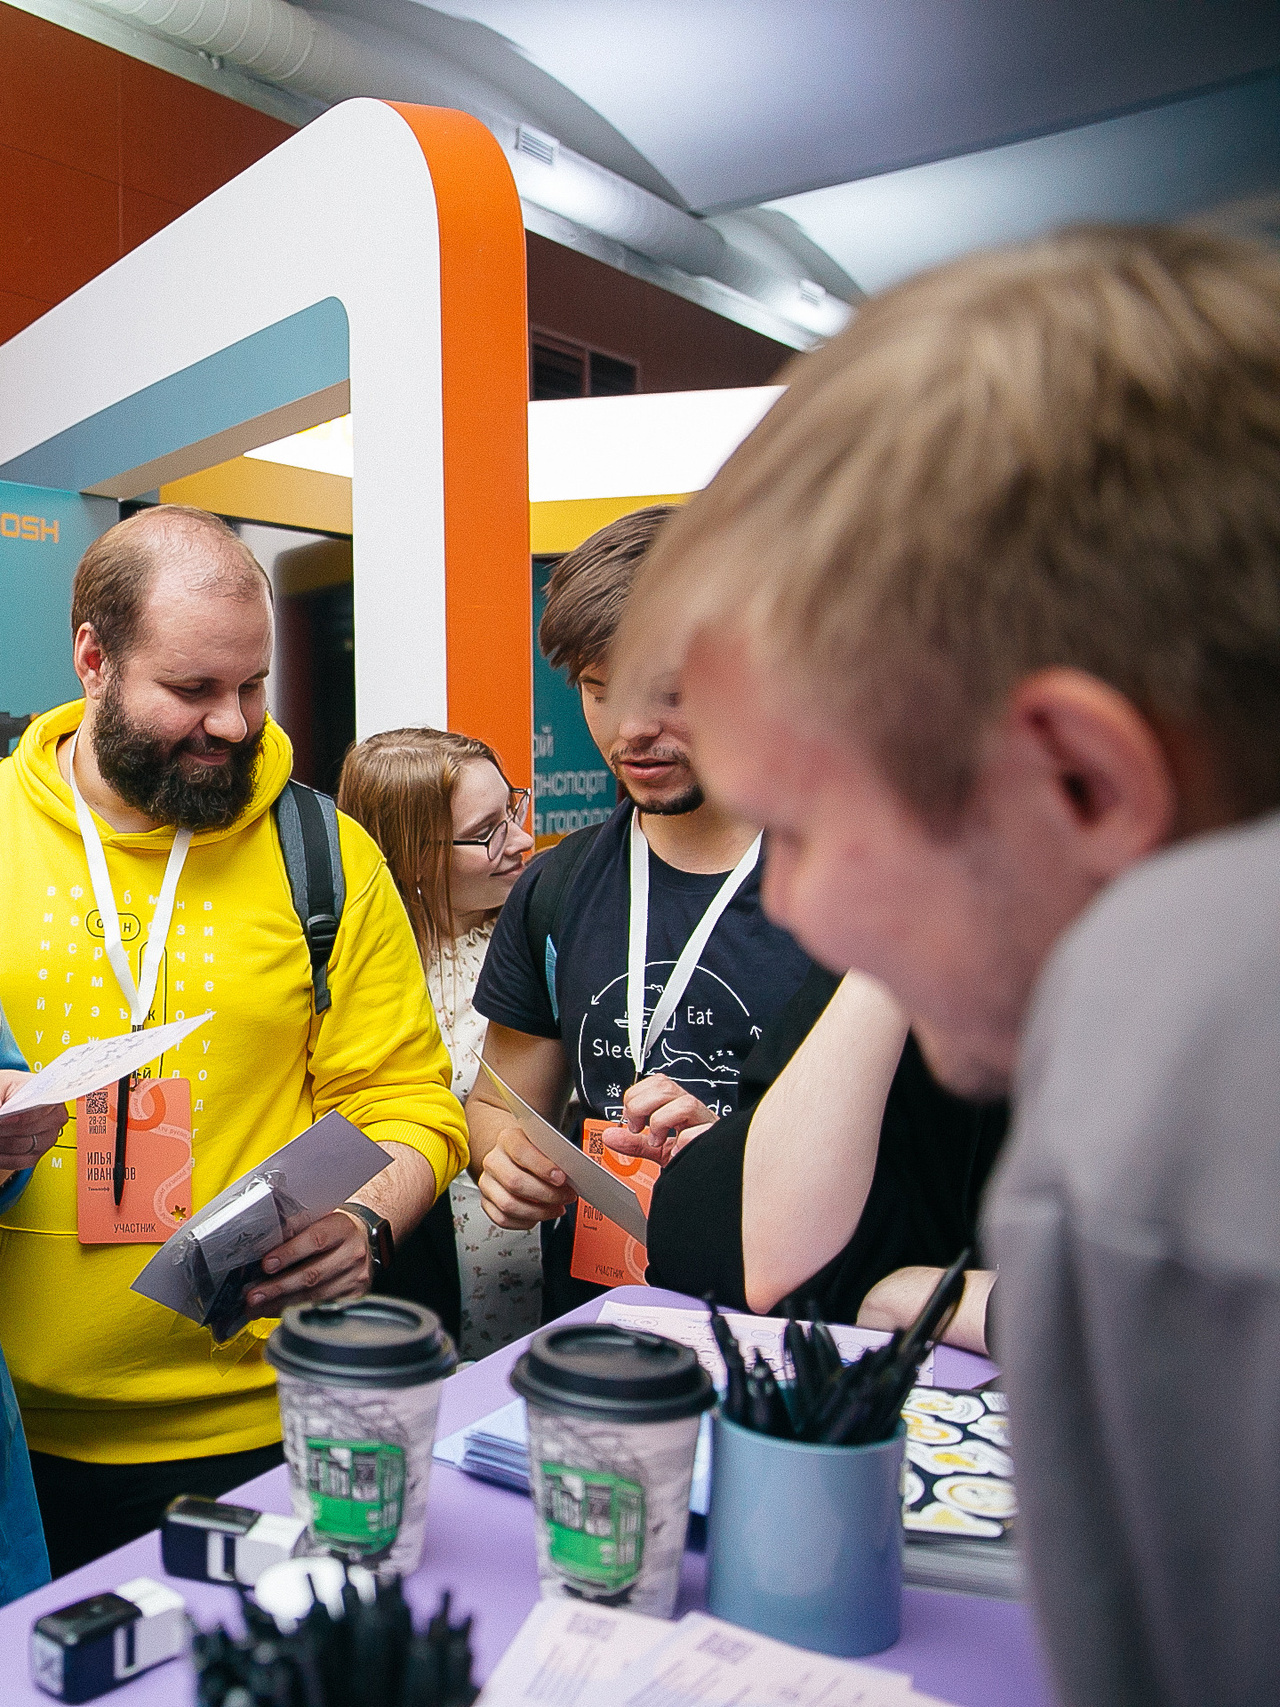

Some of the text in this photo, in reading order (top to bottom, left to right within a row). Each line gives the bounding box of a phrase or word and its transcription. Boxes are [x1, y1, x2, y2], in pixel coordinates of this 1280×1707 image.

[687, 1006, 713, 1025] Eat
[87, 1152, 112, 1165] ИЛЬЯ
[87, 1167, 136, 1181] ИВАНОВ
[113, 1223, 156, 1233] УЧАСТНИК
[595, 1264, 624, 1279] УЧАСТНИК
